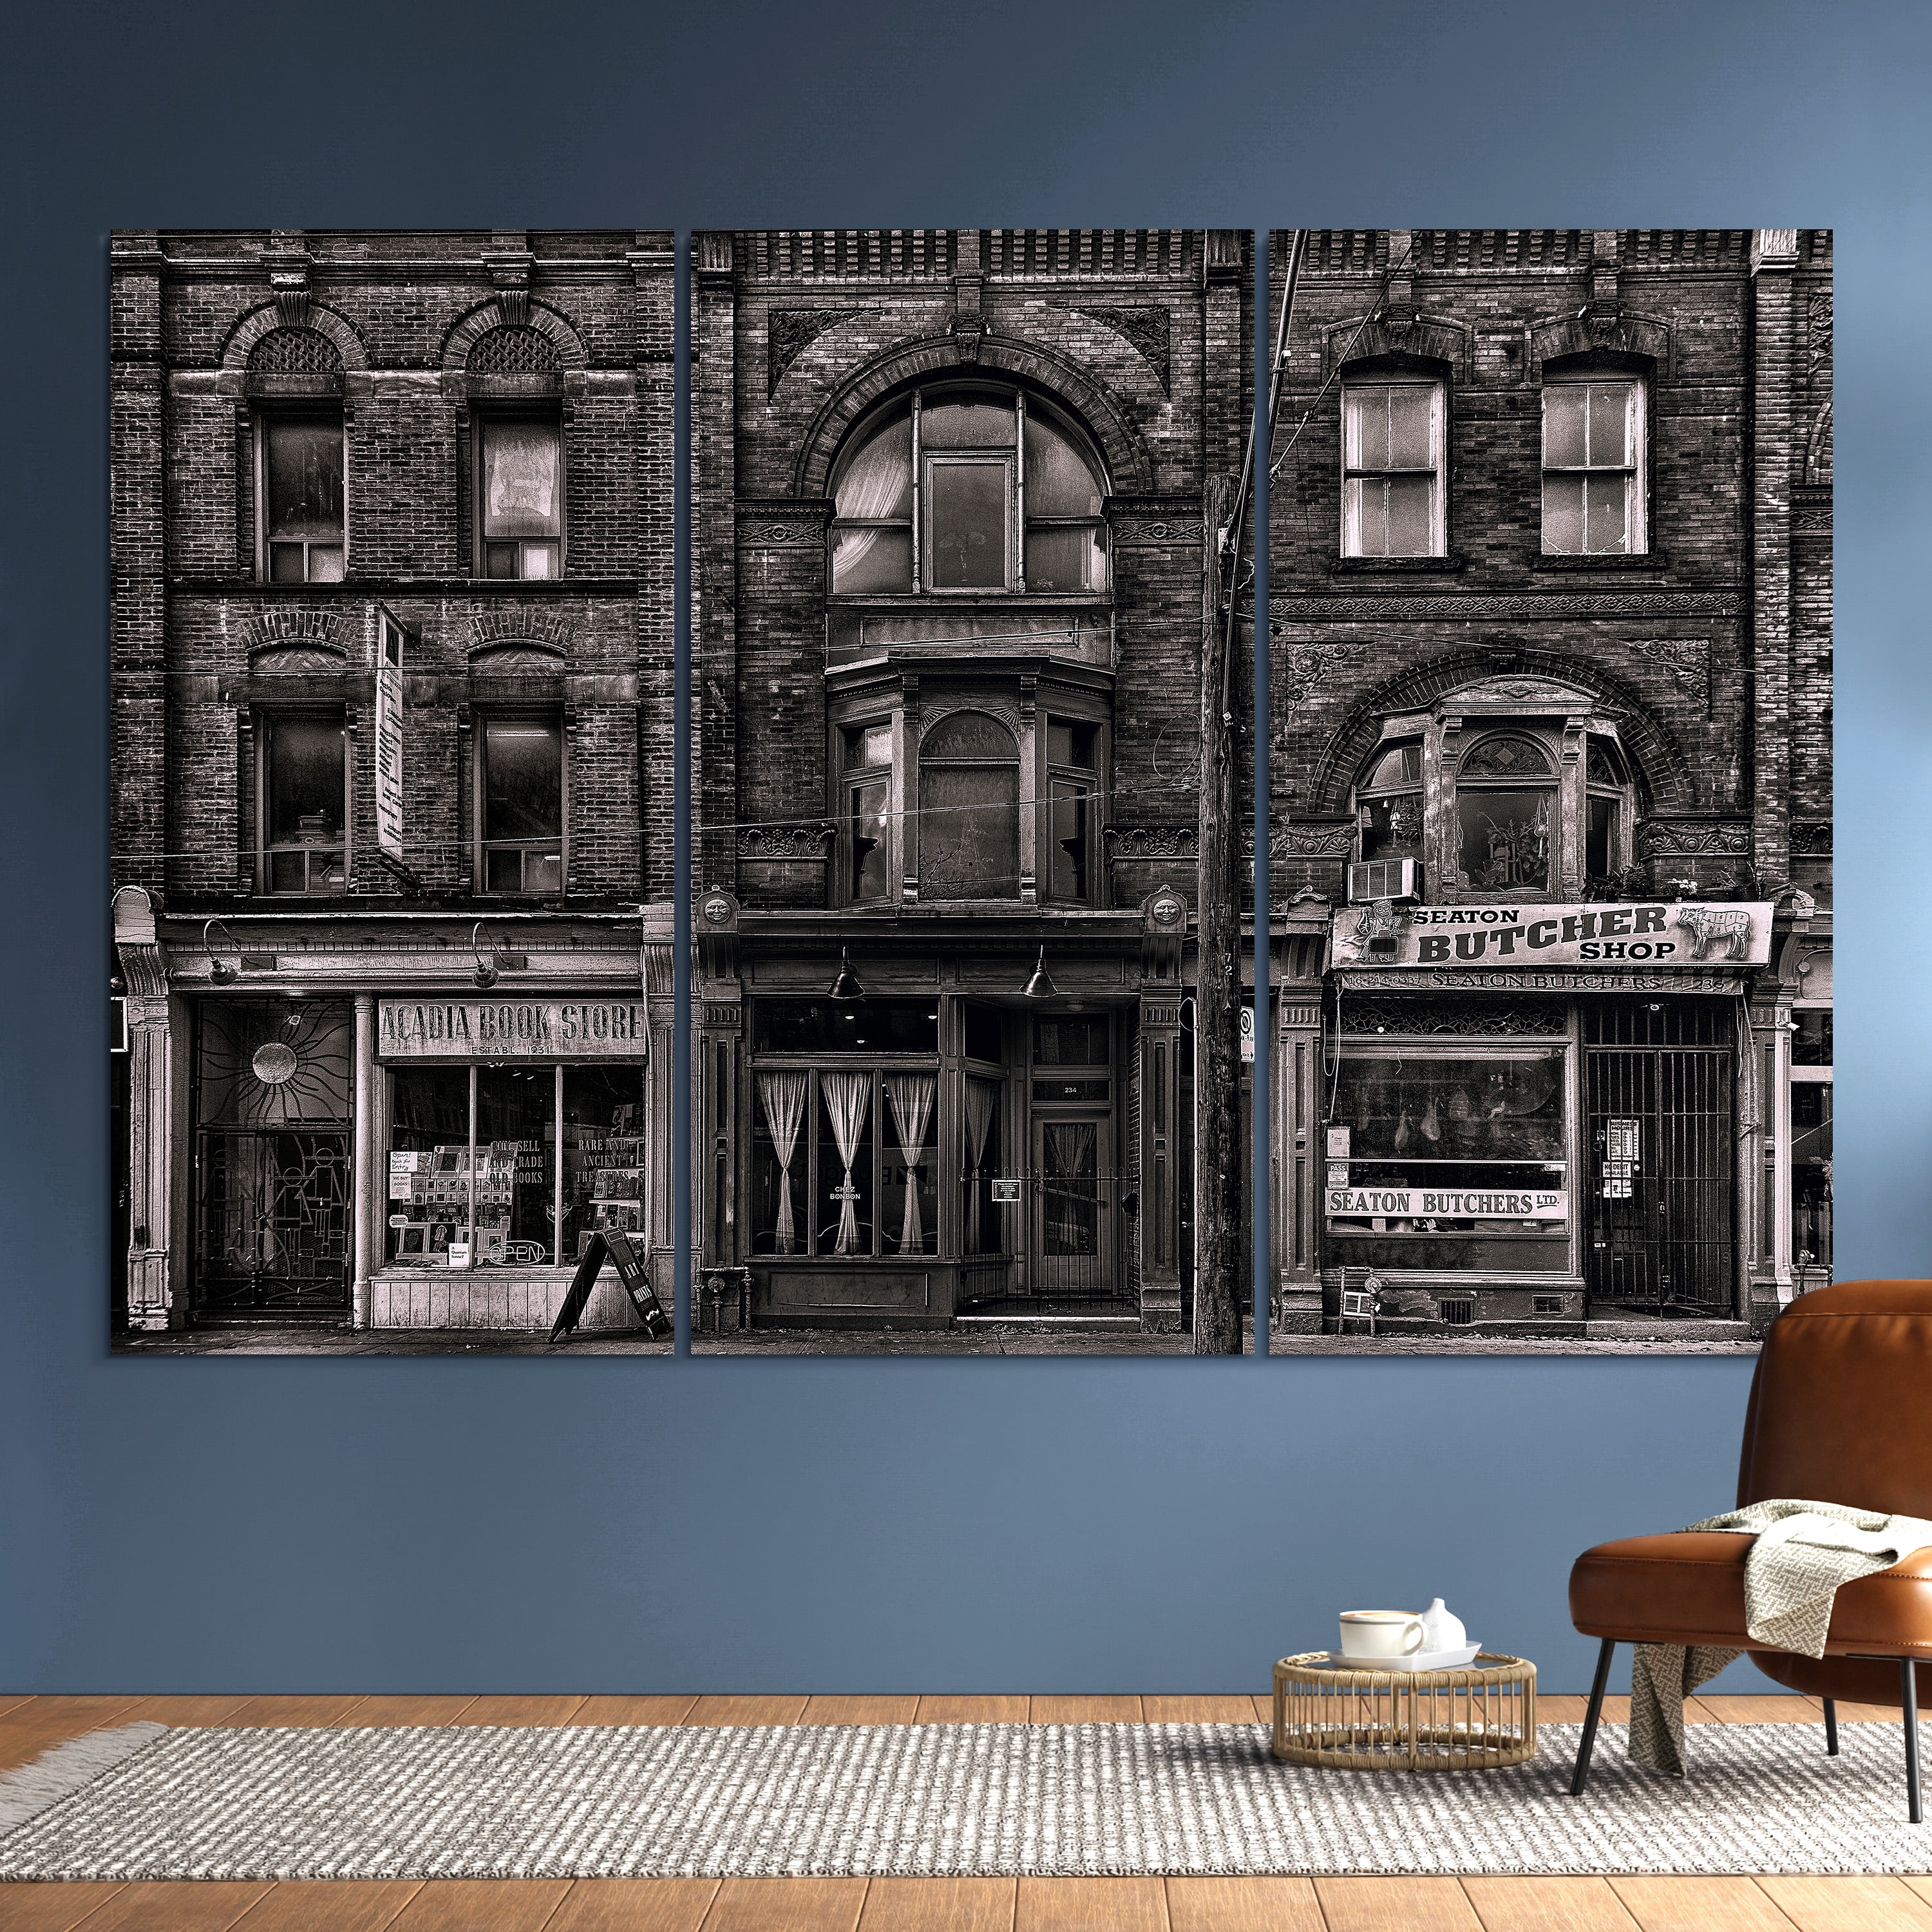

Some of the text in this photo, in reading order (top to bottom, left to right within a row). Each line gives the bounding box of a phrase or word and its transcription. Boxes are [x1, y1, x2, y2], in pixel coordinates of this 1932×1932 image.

[1413, 909, 1519, 924] SEATON
[1417, 907, 1667, 963] BUTCHER
[1580, 942, 1676, 960] SHOP
[1432, 973, 1526, 987] SEATON
[1531, 974, 1660, 990] BUTCHERS
[1692, 979, 1725, 989] 236
[381, 1005, 644, 1039] ACADIA BOOK STORE
[471, 1046, 551, 1054] ESTABL. 1931
[492, 1141, 540, 1151] BUY SELL
[578, 1139, 626, 1151] RARE AND
[582, 1155, 622, 1166] ANCIENT
[513, 1172, 542, 1184] BOOKS
[575, 1171, 629, 1182] TREASURES
[1330, 1191, 1560, 1214] SEATON BUTCHERS LTD.
[490, 1244, 542, 1261] OPEN
[624, 1262, 640, 1279] ART
[633, 1284, 652, 1303] PRINTS
